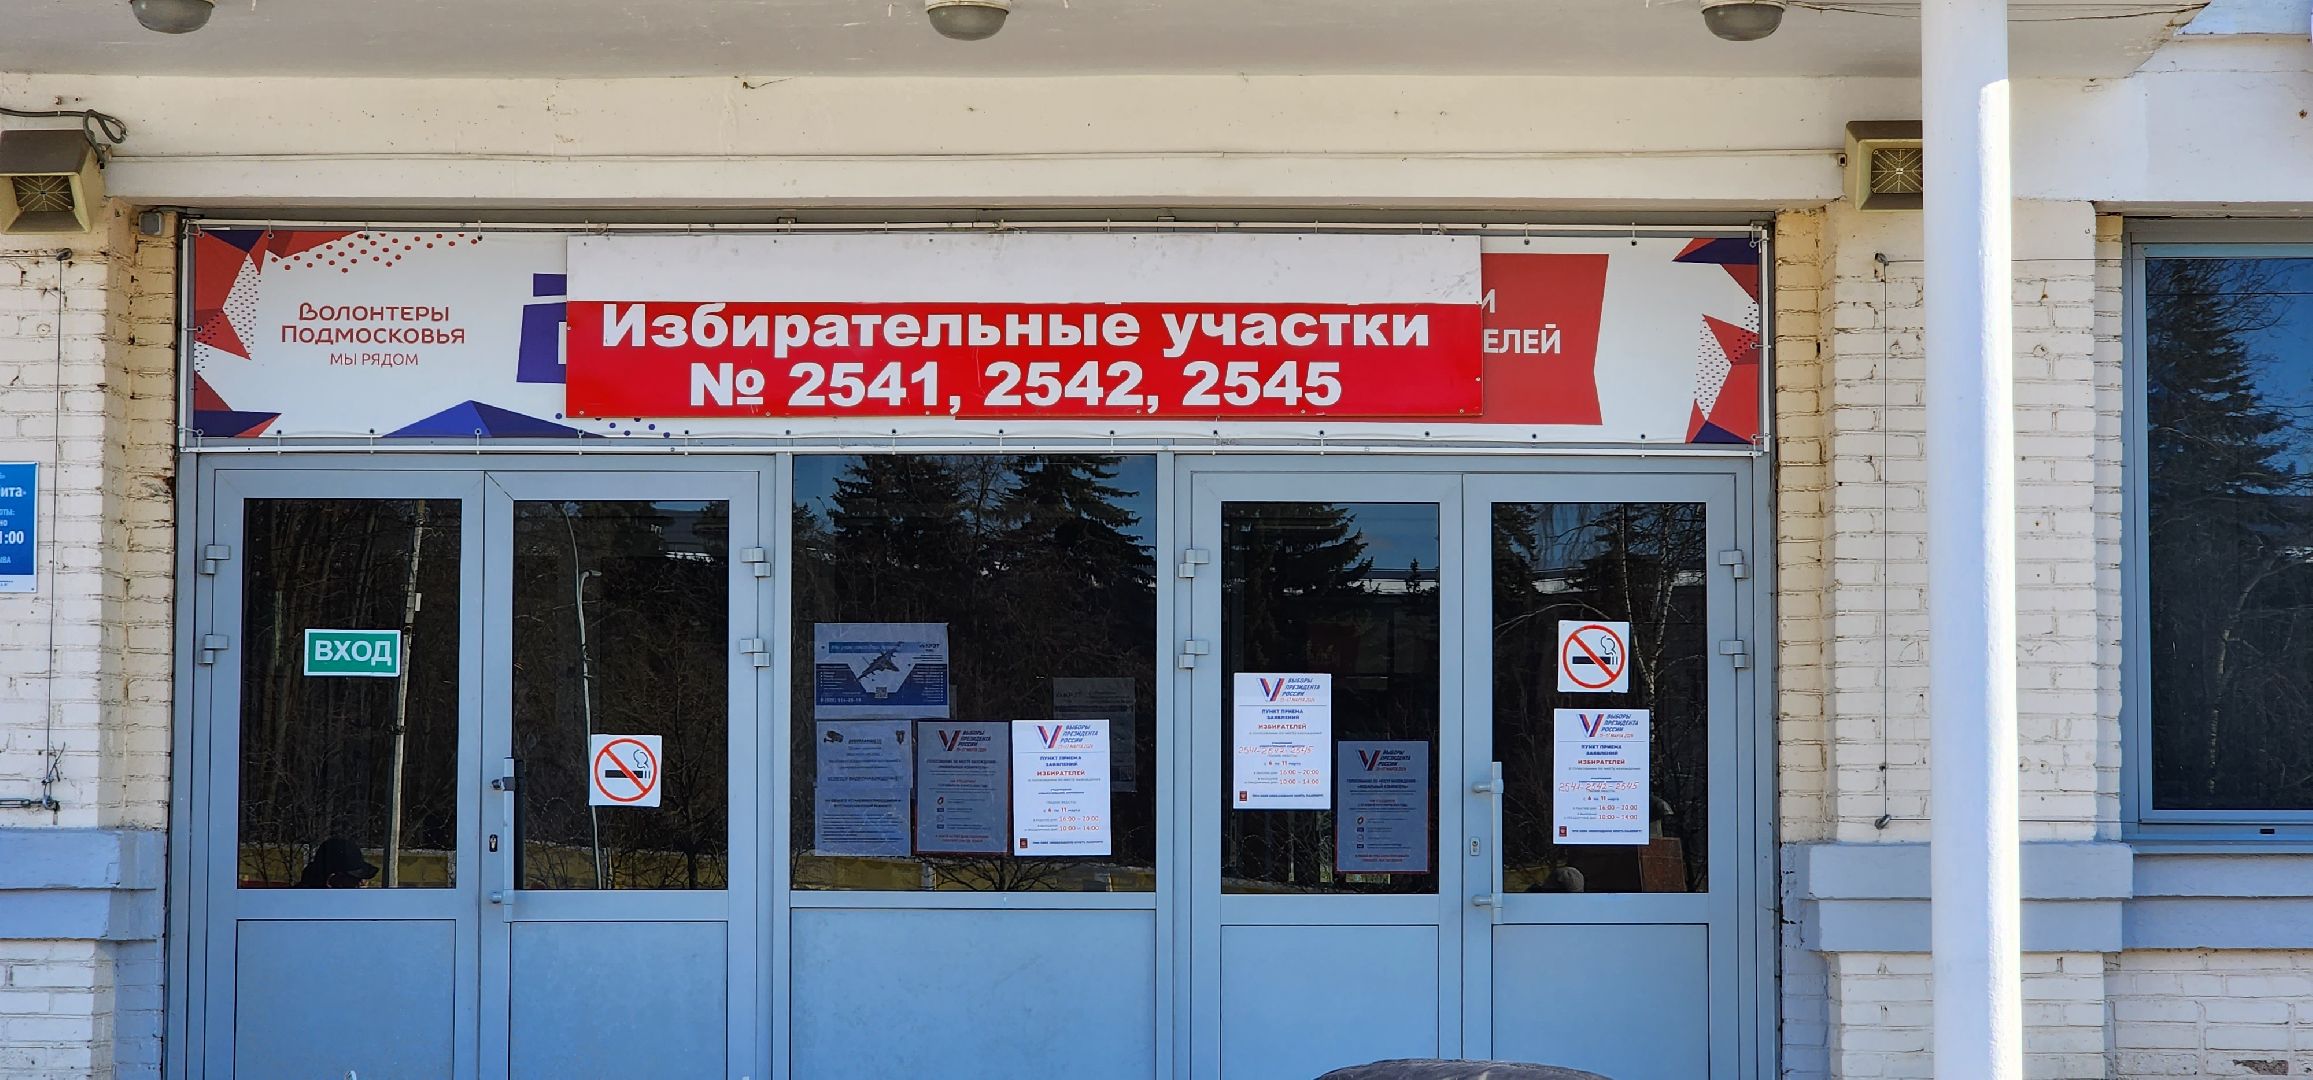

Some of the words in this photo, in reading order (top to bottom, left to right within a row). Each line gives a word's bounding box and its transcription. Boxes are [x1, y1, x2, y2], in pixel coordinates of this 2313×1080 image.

[603, 302, 1139, 359] Избирательные
[1162, 310, 1430, 359] участки
[329, 353, 358, 366] МЫ
[362, 353, 419, 368] РЯДОМ
[690, 362, 765, 406] №
[788, 361, 961, 412] 2541,
[984, 361, 1159, 412] 2542,
[1182, 360, 1342, 407] 2545
[314, 639, 393, 667] ВХОД
